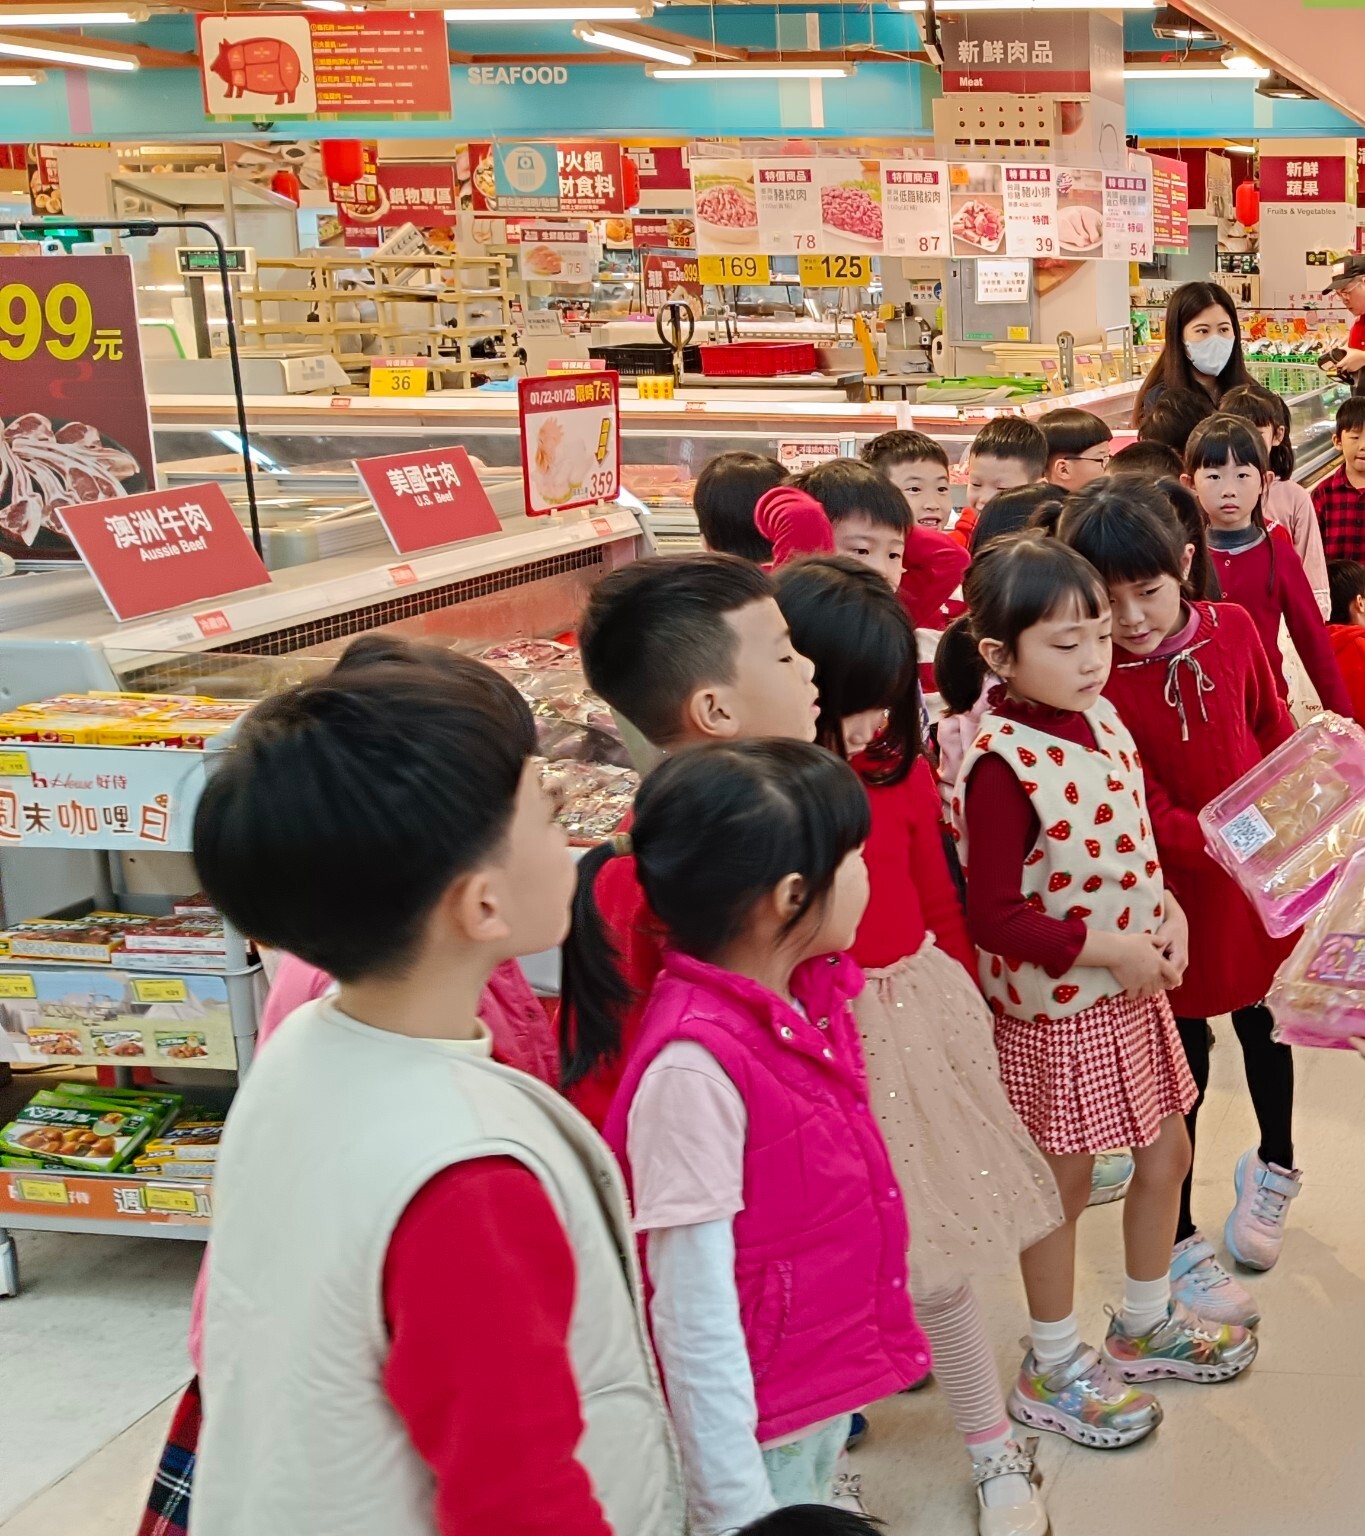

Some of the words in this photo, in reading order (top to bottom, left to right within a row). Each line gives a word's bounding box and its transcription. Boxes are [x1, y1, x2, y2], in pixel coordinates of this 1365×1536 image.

[959, 40, 1053, 63] 新鮮肉品
[468, 67, 568, 84] SEAFOOD
[960, 77, 984, 87] Meat
[765, 171, 807, 182] 特價商品
[1009, 169, 1048, 180] 特價商品
[1286, 161, 1319, 177] 新鮮
[892, 172, 934, 184] 特價商品
[390, 187, 453, 204] 鍋物專區
[1022, 186, 1050, 198] 豬小排
[1286, 180, 1319, 196] 蔬果
[1267, 207, 1288, 215] Fruits
[1297, 207, 1336, 216] Vegetables
[673, 236, 691, 247] 599
[793, 234, 816, 249] 78
[919, 236, 941, 251] 87
[1036, 237, 1053, 252] 39
[1130, 243, 1147, 256] 54
[719, 257, 757, 277] 169
[821, 255, 862, 278] 125
[391, 375, 411, 390] 36
[386, 461, 461, 496] 美國牛肉
[590, 473, 615, 498] 359
[436, 491, 454, 504] Beef
[104, 502, 214, 549] 澳洲牛肉
[139, 542, 181, 562] Aussie
[182, 538, 208, 556] Beef
